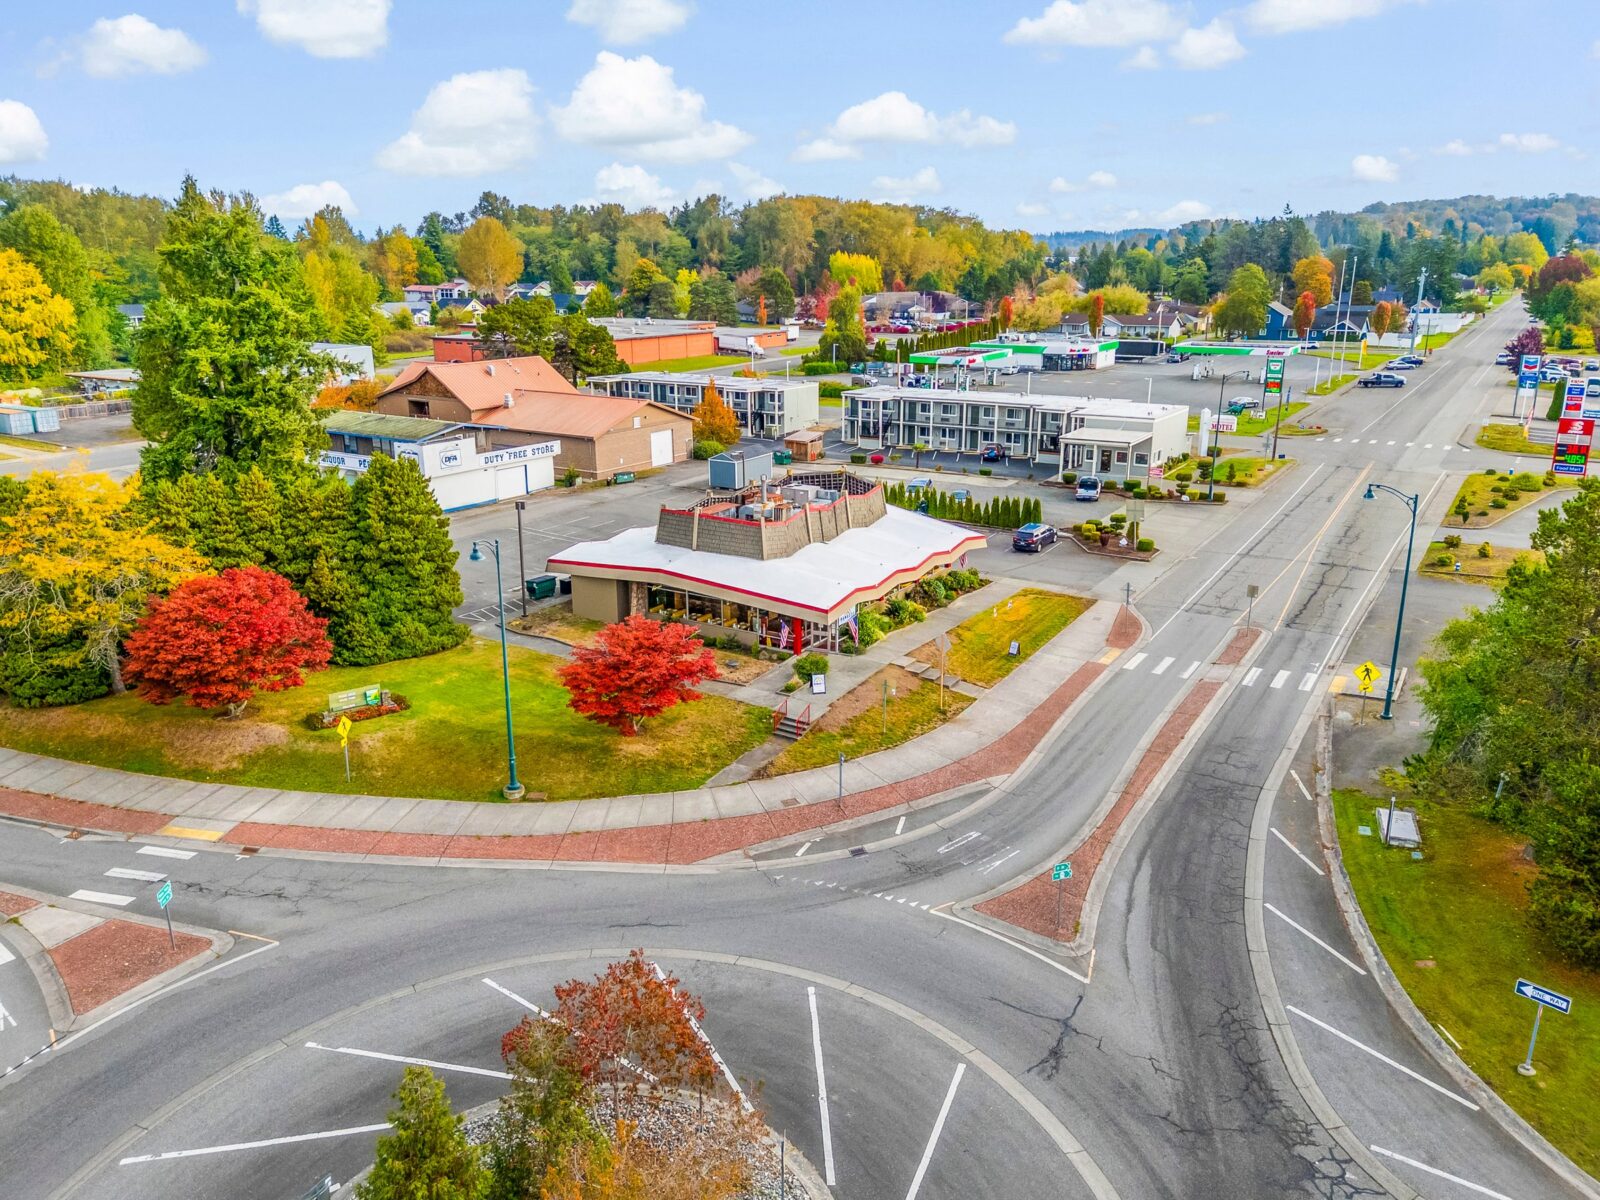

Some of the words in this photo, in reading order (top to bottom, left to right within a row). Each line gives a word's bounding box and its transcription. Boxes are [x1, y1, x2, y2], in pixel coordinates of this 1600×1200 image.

[1211, 423, 1234, 431] MOTEL
[484, 454, 504, 464] DUTY
[508, 450, 527, 460] FREE
[531, 445, 554, 455] STORE
[1532, 990, 1545, 1000] ONE
[1549, 997, 1564, 1006] WAY
